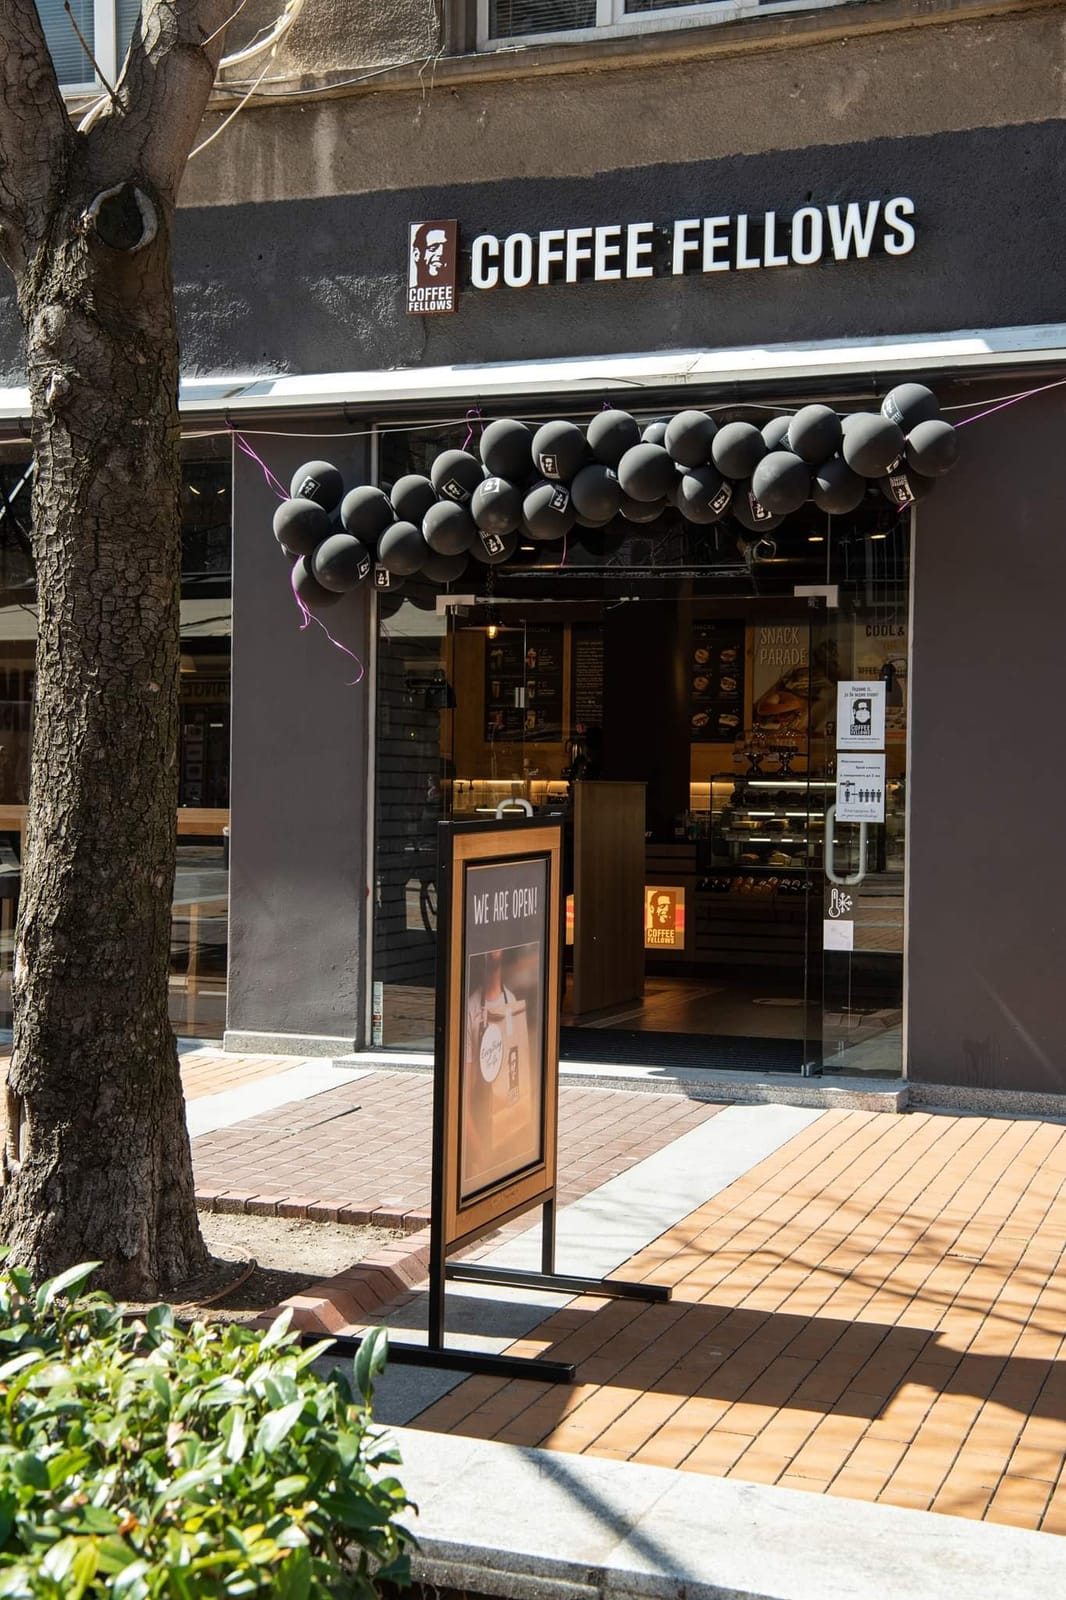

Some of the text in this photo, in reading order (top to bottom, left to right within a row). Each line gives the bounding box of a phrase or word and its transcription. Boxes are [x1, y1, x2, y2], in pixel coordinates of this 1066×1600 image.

[470, 196, 916, 290] COFFEE FELLOWS
[409, 286, 453, 302] COFFEE
[408, 300, 452, 312] FELLOWS
[760, 626, 800, 645] SNACK
[865, 624, 896, 637] COOL
[760, 647, 807, 665] PARADE
[474, 887, 538, 925] WE ARE OPEN!
[647, 928, 675, 938] COFFEE
